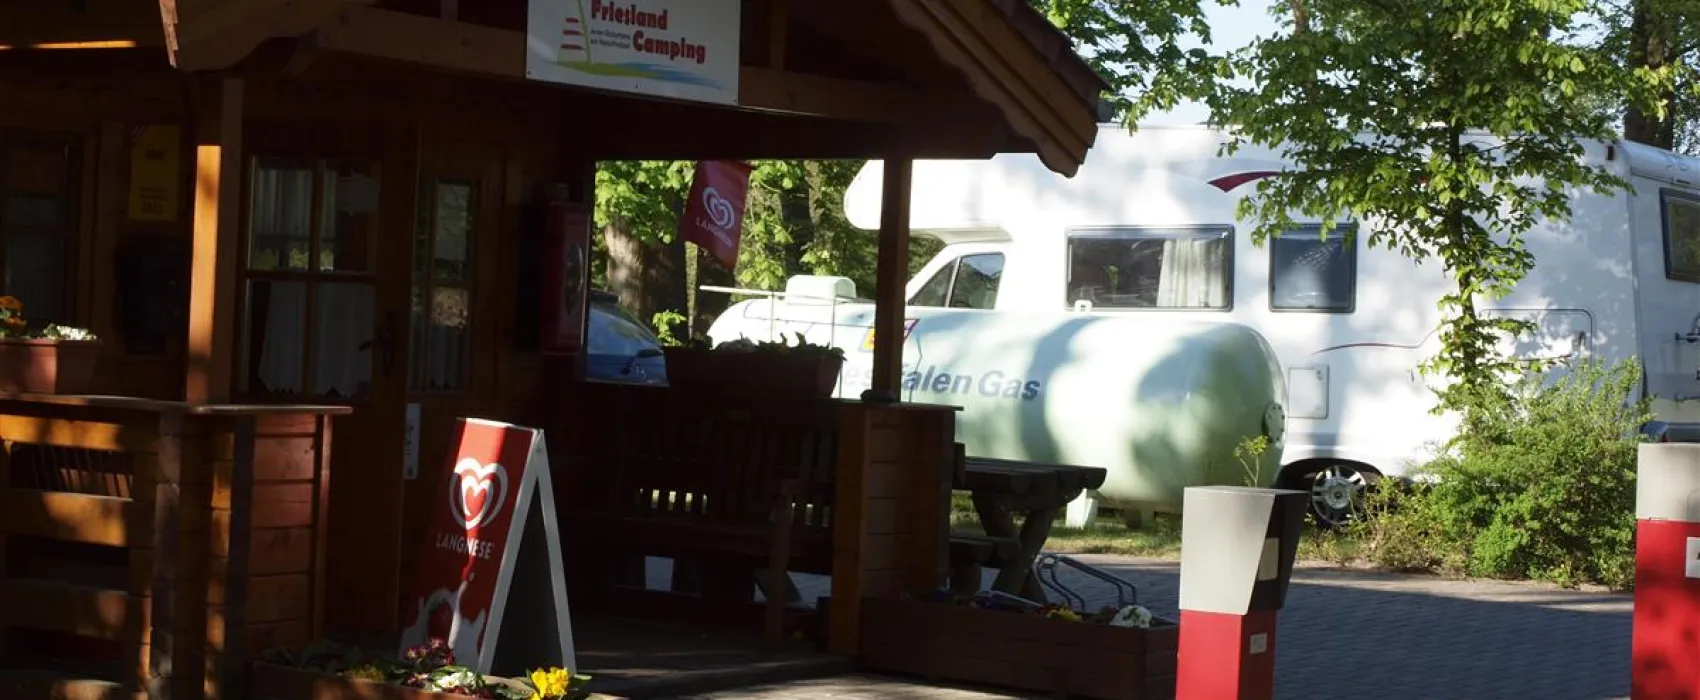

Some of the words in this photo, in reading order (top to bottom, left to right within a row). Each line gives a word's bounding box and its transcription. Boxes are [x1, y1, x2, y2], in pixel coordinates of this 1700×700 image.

[591, 0, 668, 30] Friesland
[633, 30, 706, 64] Camping
[978, 369, 1041, 401] Gas
[435, 531, 495, 560] LANGNESE
